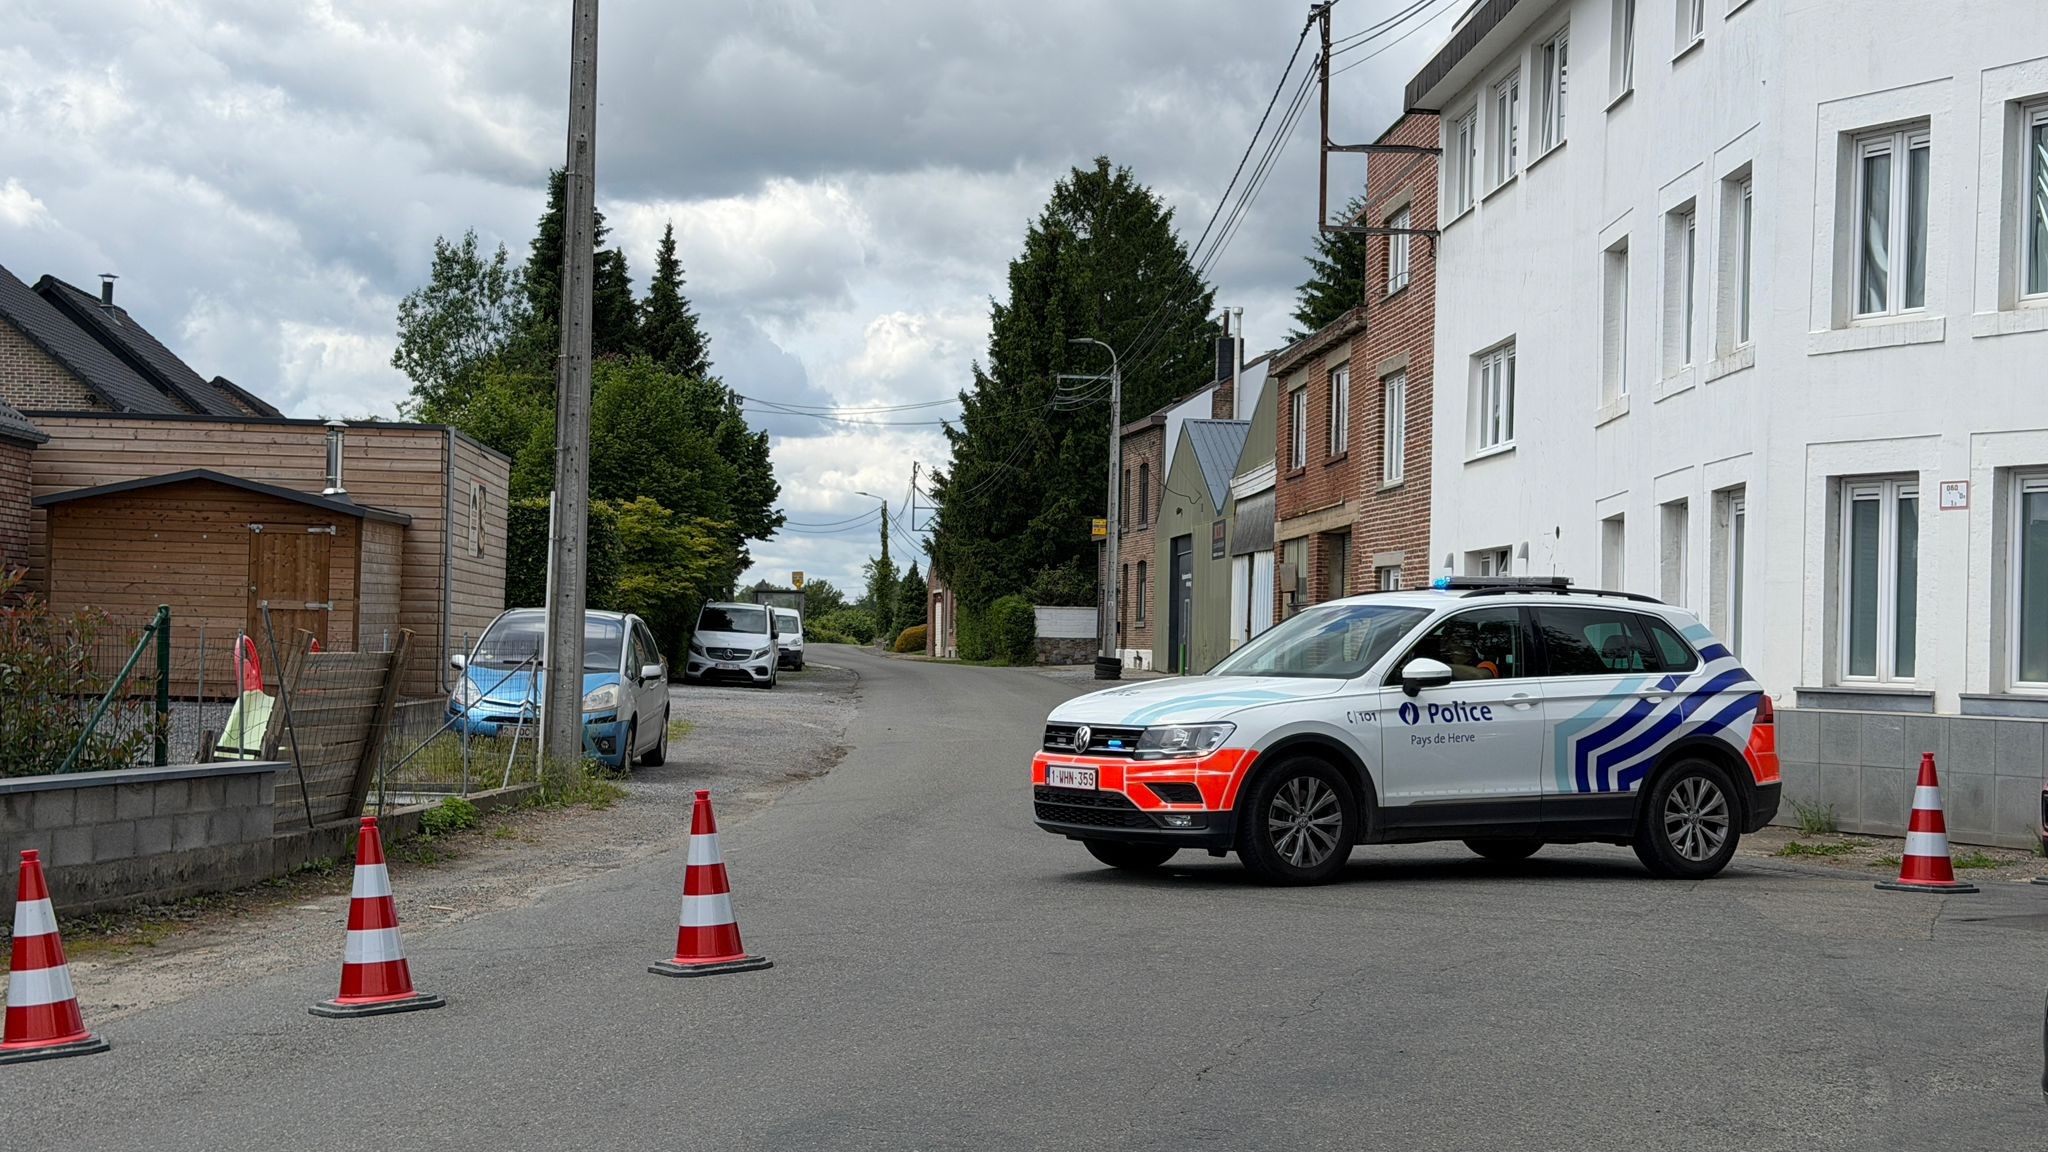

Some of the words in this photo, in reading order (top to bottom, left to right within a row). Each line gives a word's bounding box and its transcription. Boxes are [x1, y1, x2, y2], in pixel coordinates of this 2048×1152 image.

[1359, 712, 1377, 722] 101
[1427, 701, 1493, 724] Police
[1411, 734, 1432, 748] Pays
[1434, 733, 1446, 744] de
[1448, 733, 1475, 744] Herve
